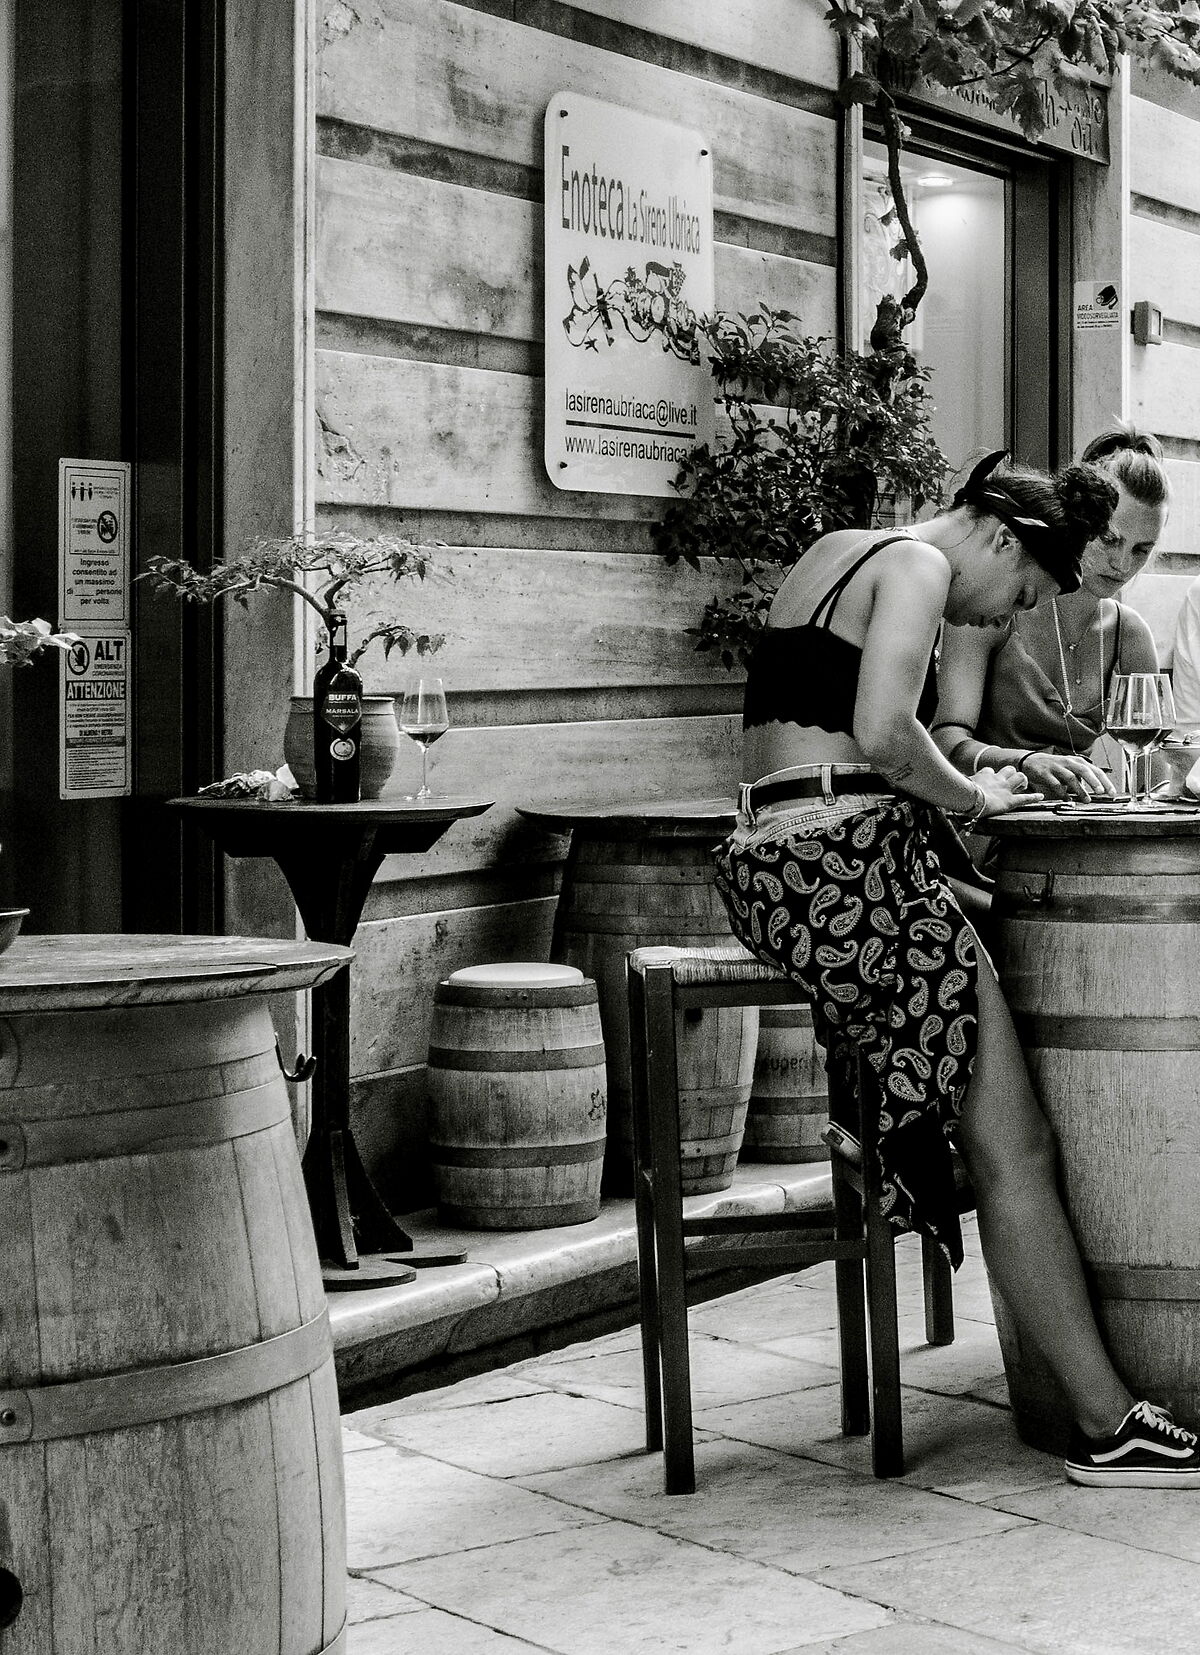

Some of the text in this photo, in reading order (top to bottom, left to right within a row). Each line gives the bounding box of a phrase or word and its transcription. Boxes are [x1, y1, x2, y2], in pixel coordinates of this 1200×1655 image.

[561, 144, 701, 255] Enoteca La Sirena Ubriaca
[565, 387, 698, 427] lasirenaubriaca@live.it
[565, 434, 697, 464] www.lasirenaubriaca
[80, 558, 110, 567] Ingresso
[94, 640, 124, 661] ALT
[67, 681, 125, 699] ATTENZIONE
